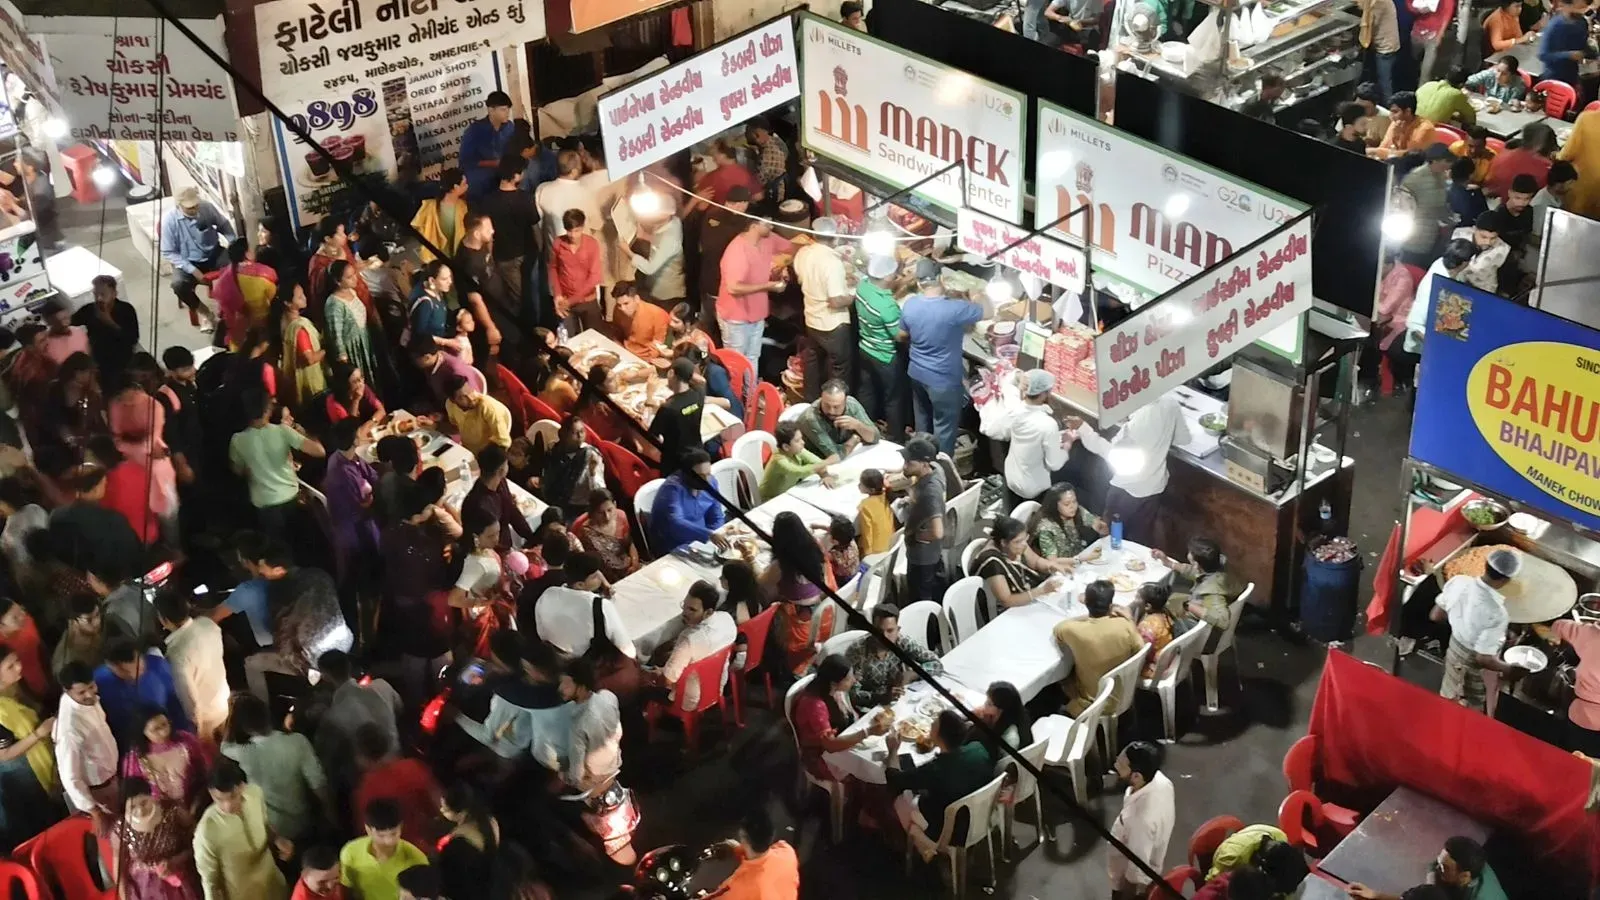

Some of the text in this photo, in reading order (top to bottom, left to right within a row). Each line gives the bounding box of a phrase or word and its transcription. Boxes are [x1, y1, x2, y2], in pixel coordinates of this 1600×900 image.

[280, 46, 330, 76] ચોકસી
[337, 34, 401, 63] જયકુમાર
[408, 16, 460, 45] નેમીચંદ
[466, 7, 500, 28] એન્ડ
[828, 36, 862, 56] MILLETS
[106, 50, 171, 75] ચોકસી
[408, 59, 477, 85] JAMUN SHOTS
[166, 77, 226, 99] પ્રેમચંદ
[410, 75, 471, 99] OREO SHOTS
[413, 86, 483, 113] SITAFAL SHOTS
[416, 108, 462, 127] DADAGIRI
[879, 101, 1010, 187] MANEK
[1070, 128, 1111, 151] MILLETS
[878, 142, 1011, 209] Sandwich Center
[1485, 363, 1600, 443] BAHU
[1526, 465, 1567, 496] MANEK
